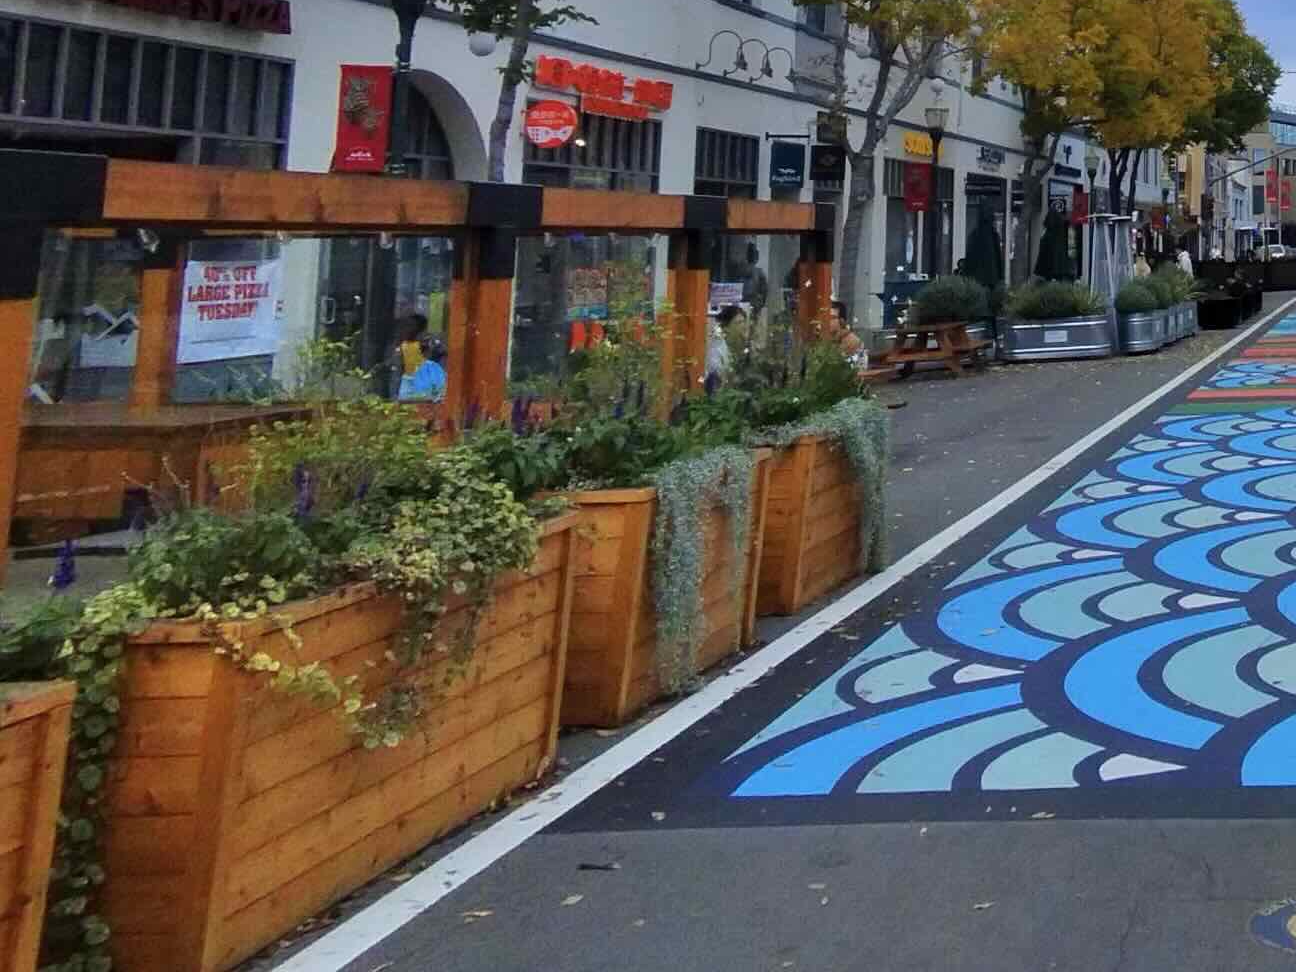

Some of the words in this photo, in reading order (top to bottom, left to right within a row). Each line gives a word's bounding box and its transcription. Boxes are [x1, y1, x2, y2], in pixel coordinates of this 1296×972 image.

[233, 266, 257, 282] OFF
[188, 284, 231, 302] LARGE
[235, 282, 268, 299] PIZZA
